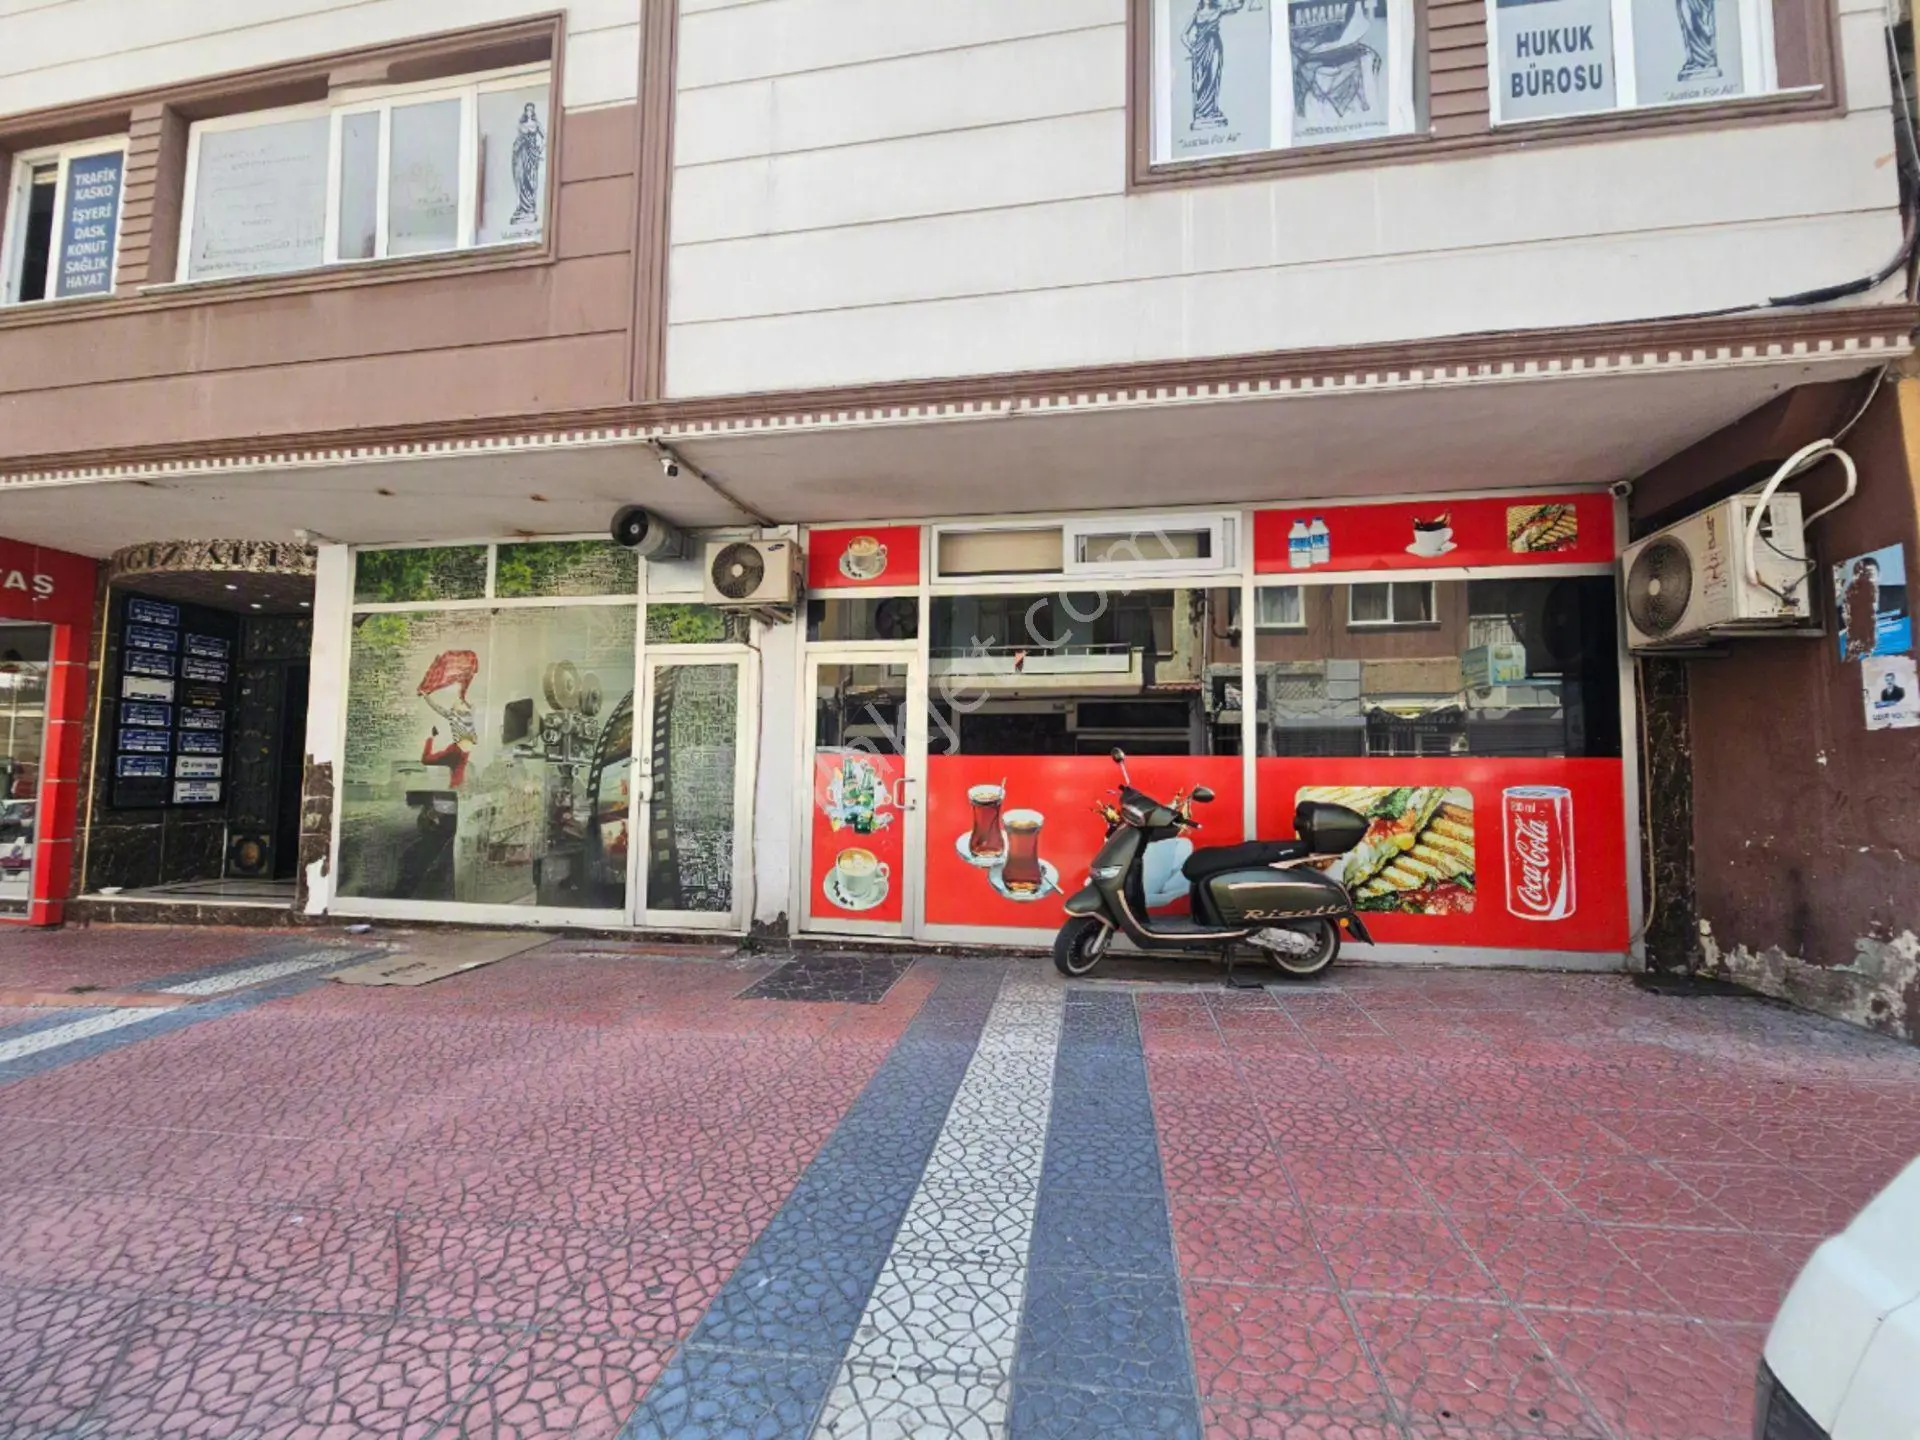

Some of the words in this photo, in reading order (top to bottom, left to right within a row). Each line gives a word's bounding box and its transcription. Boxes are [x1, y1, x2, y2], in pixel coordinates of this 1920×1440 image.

[1516, 25, 1594, 58] HUKUK
[1511, 63, 1603, 98] BÜROSU
[74, 167, 118, 186] TRAFİK
[75, 184, 114, 201] KASKO
[72, 202, 112, 224] İŞYERİ
[74, 224, 106, 240] DASK
[67, 240, 108, 257] KONUT
[65, 257, 109, 274] SAĞLIK
[66, 273, 105, 289] HAYAT
[0, 568, 54, 600] AŞ
